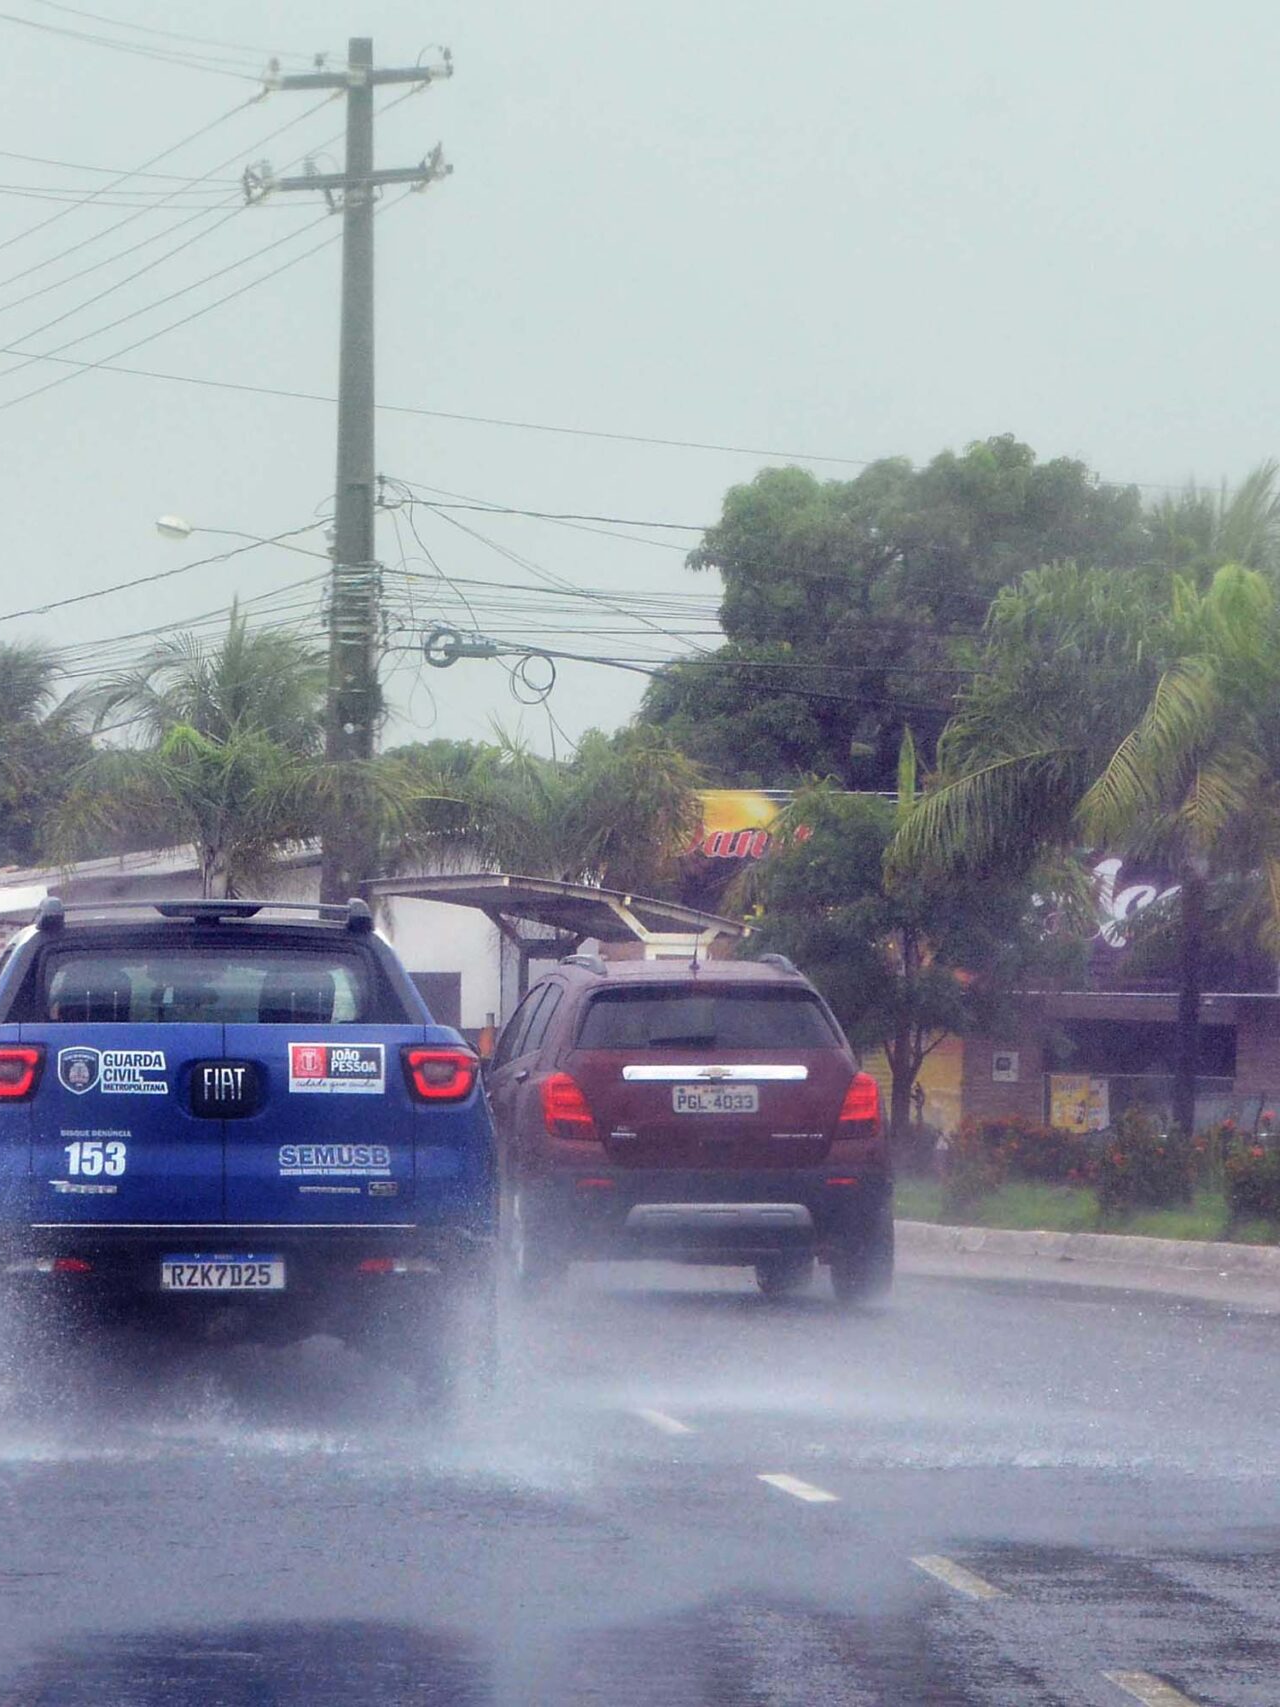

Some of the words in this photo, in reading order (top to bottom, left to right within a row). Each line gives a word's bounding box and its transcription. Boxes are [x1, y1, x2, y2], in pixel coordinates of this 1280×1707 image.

[103, 1053, 163, 1068] GUARDA
[330, 1049, 360, 1061] JOÃO
[330, 1061, 378, 1073] PESSOA
[102, 1068, 144, 1083] CIVIL
[102, 1083, 167, 1092] METROPOLITANA
[203, 1067, 246, 1101] FIAT
[64, 1141, 127, 1176] 153
[280, 1145, 389, 1166] SEMUSB
[171, 1264, 271, 1287] RZK7D25
